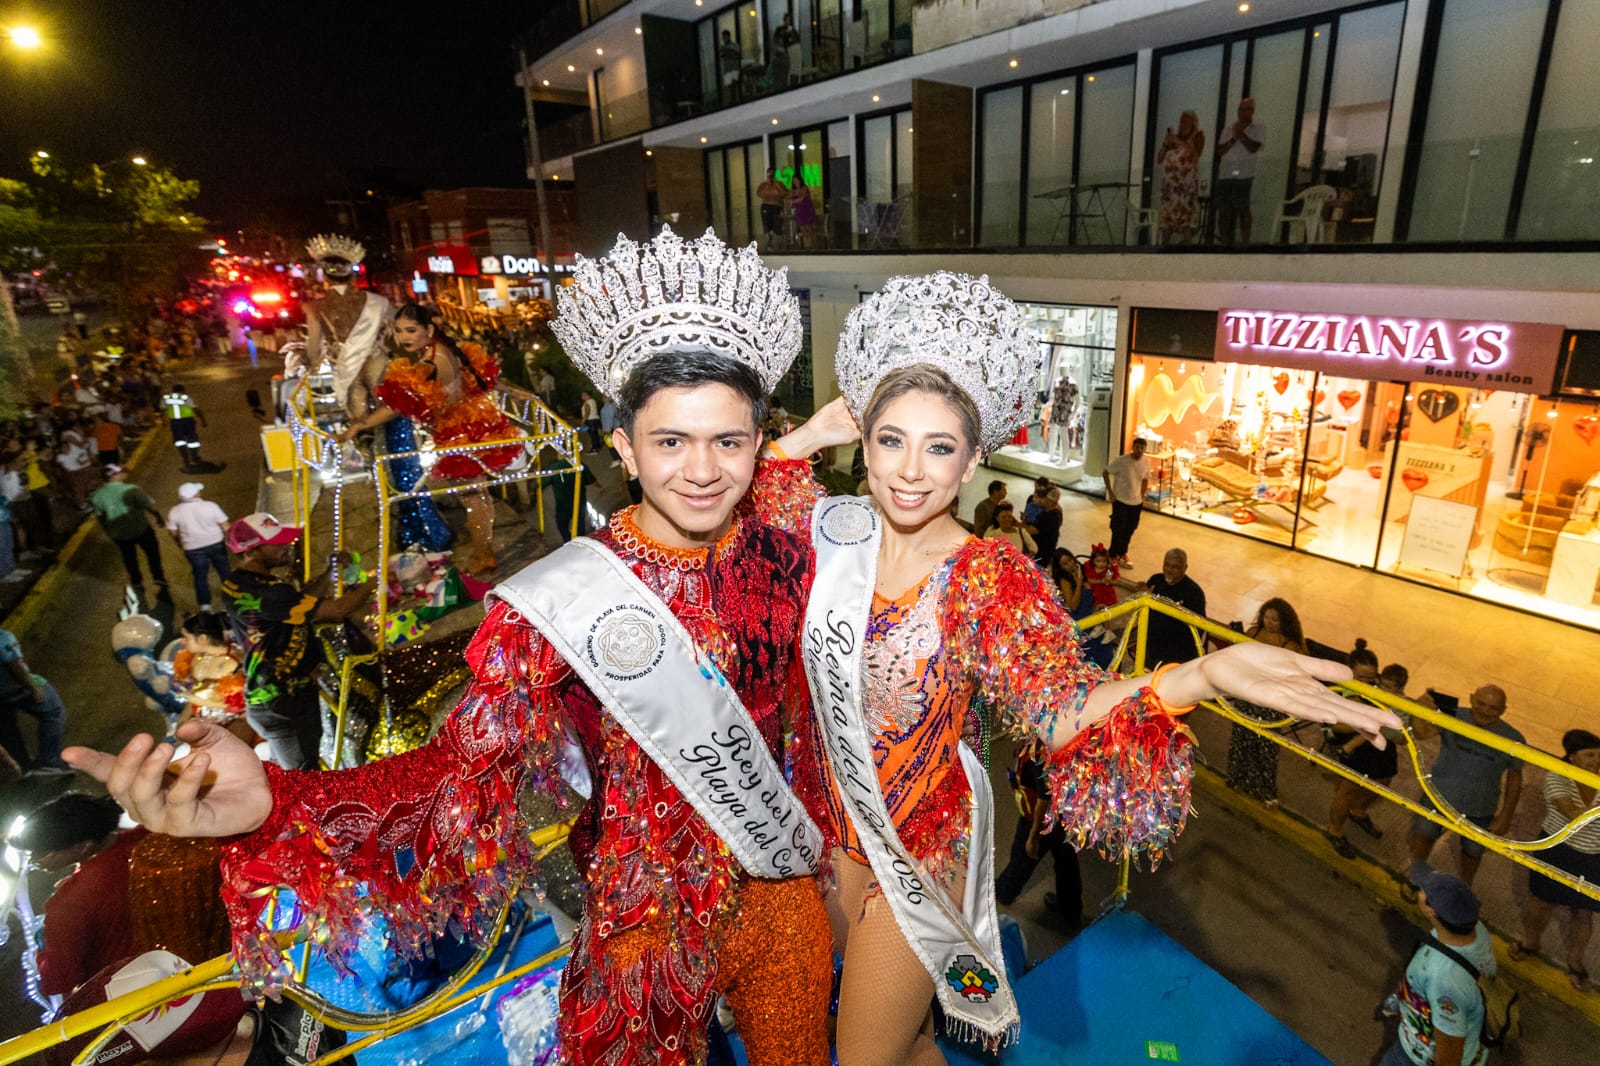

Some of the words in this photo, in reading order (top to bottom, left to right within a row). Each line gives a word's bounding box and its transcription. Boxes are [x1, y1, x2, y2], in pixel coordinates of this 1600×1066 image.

[1424, 365, 1480, 381] Beauty
[1486, 372, 1534, 385] salon
[597, 608, 614, 623] PLAYA
[615, 603, 628, 611] DEL
[629, 604, 656, 620] CARMEN
[590, 623, 598, 633] DE
[657, 623, 667, 646] TODOS
[587, 635, 599, 668] GOBIERNO
[652, 650, 665, 667] PARA
[605, 667, 653, 682] PROSPERIDAD
[826, 609, 855, 729] Reina
[838, 735, 871, 794] del
[711, 724, 762, 791] Rey
[760, 790, 792, 828] del
[679, 744, 748, 819] Playa
[743, 820, 779, 851] del
[883, 842, 930, 906] 2026
